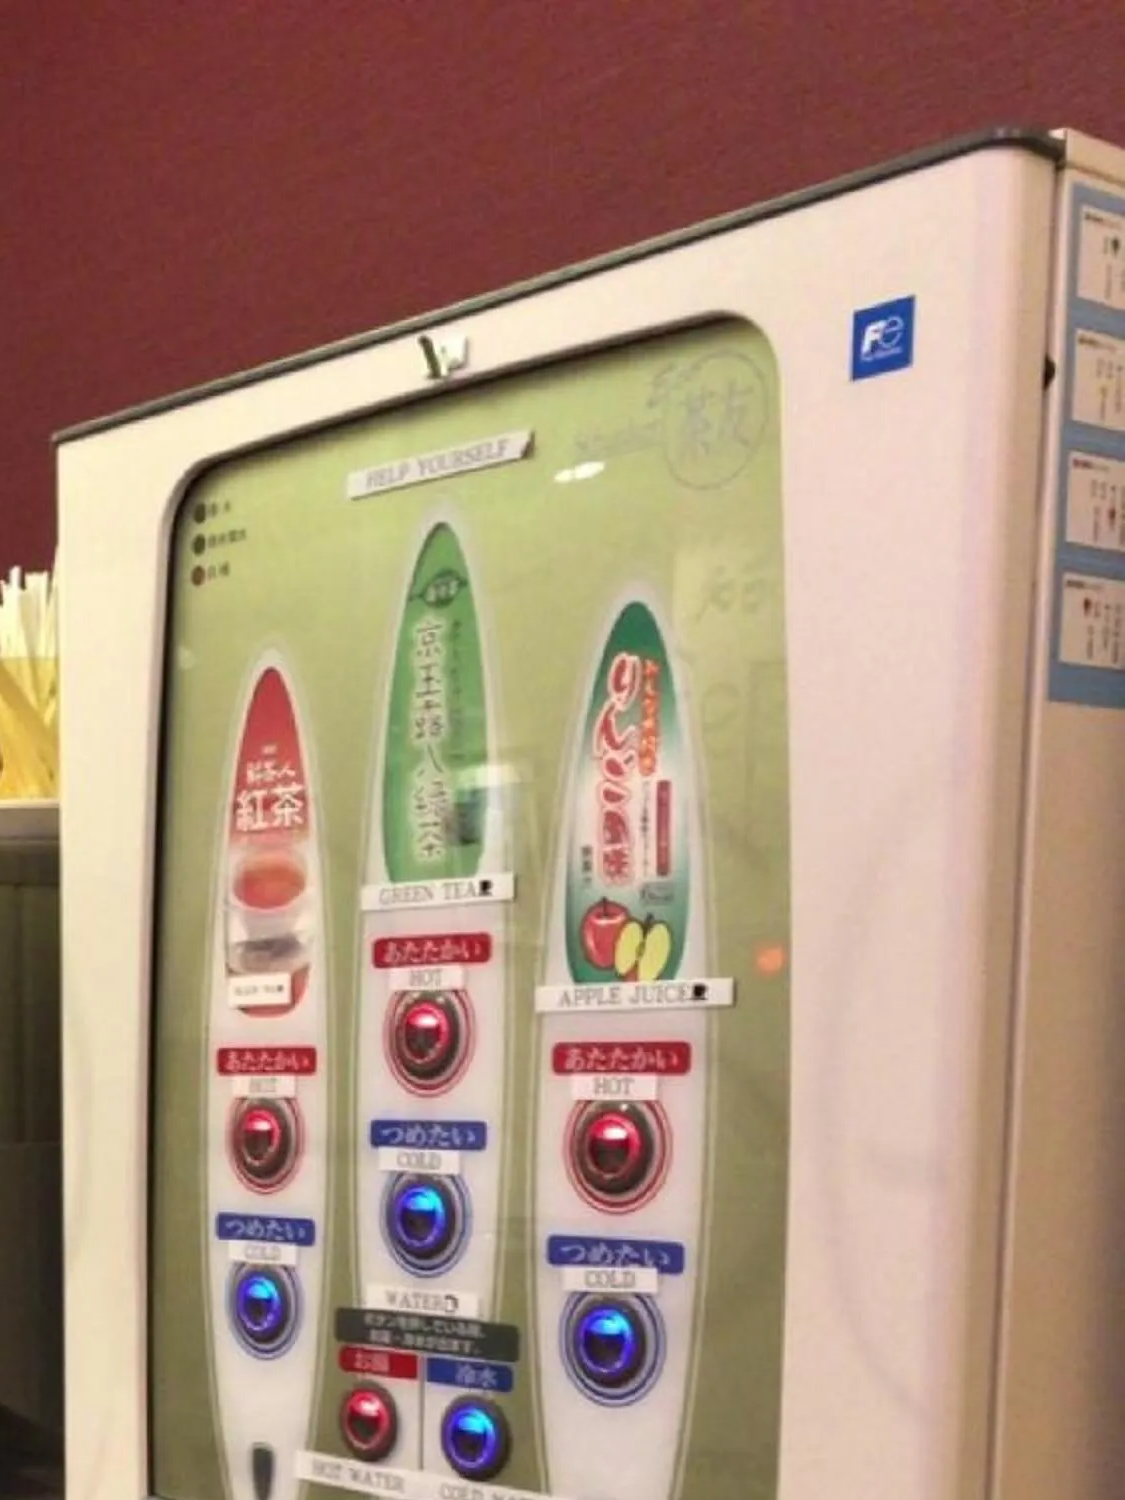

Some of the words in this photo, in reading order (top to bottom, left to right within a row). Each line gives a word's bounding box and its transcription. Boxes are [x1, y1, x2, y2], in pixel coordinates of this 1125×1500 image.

[365, 463, 409, 489] HELP
[416, 438, 509, 477] YOURSELF
[236, 783, 304, 832] 紅茶
[378, 885, 434, 905] GREEN
[442, 880, 476, 900] TEA
[383, 938, 482, 965] あたたかい
[409, 969, 443, 987] HOT
[557, 986, 620, 1008] APPLE
[628, 982, 690, 1004] JUICE
[225, 1049, 311, 1072] あたたかい
[564, 1046, 680, 1073] あたたかい
[593, 1076, 635, 1096] HOT
[380, 1122, 476, 1147] つめたい
[395, 1150, 443, 1168] COLD
[225, 1217, 306, 1241] つめたい
[244, 1243, 282, 1259] COLD
[559, 1242, 671, 1269] つめたい
[583, 1270, 636, 1289] COLD
[385, 1290, 444, 1312] WATER
[454, 1363, 498, 1388] 冷水
[311, 1459, 343, 1480] HOT
[349, 1466, 405, 1493] WATER
